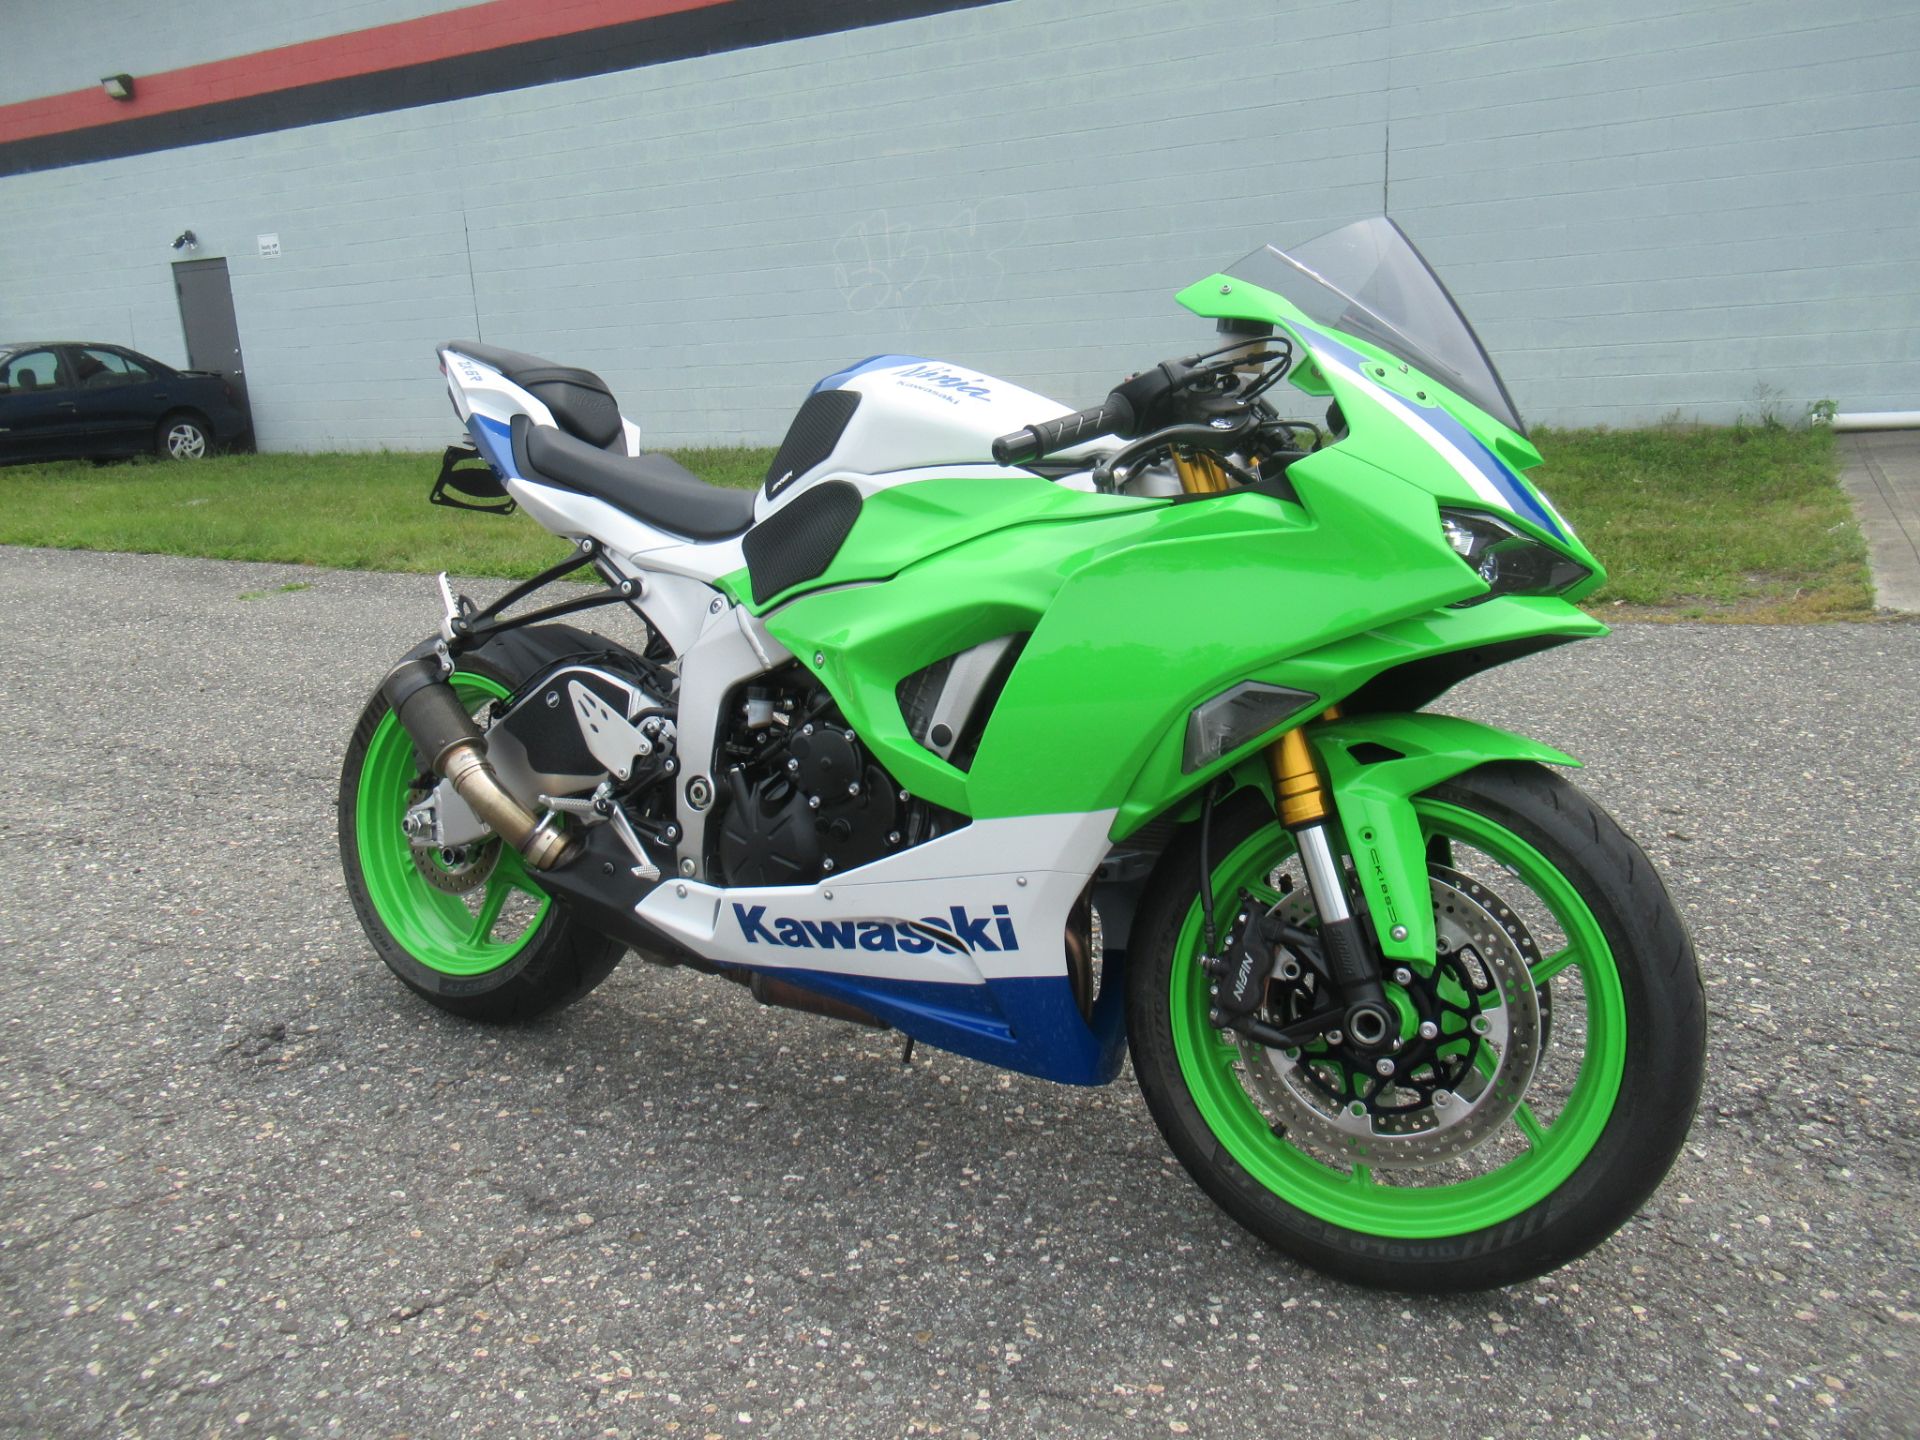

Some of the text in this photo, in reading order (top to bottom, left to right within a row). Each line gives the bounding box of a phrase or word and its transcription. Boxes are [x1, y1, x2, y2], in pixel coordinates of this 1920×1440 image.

[892, 365, 990, 402] Ninja
[897, 380, 960, 404] Kawasaki
[733, 903, 1020, 955] Kawasaki
[1232, 951, 1254, 1003] NISSIN
